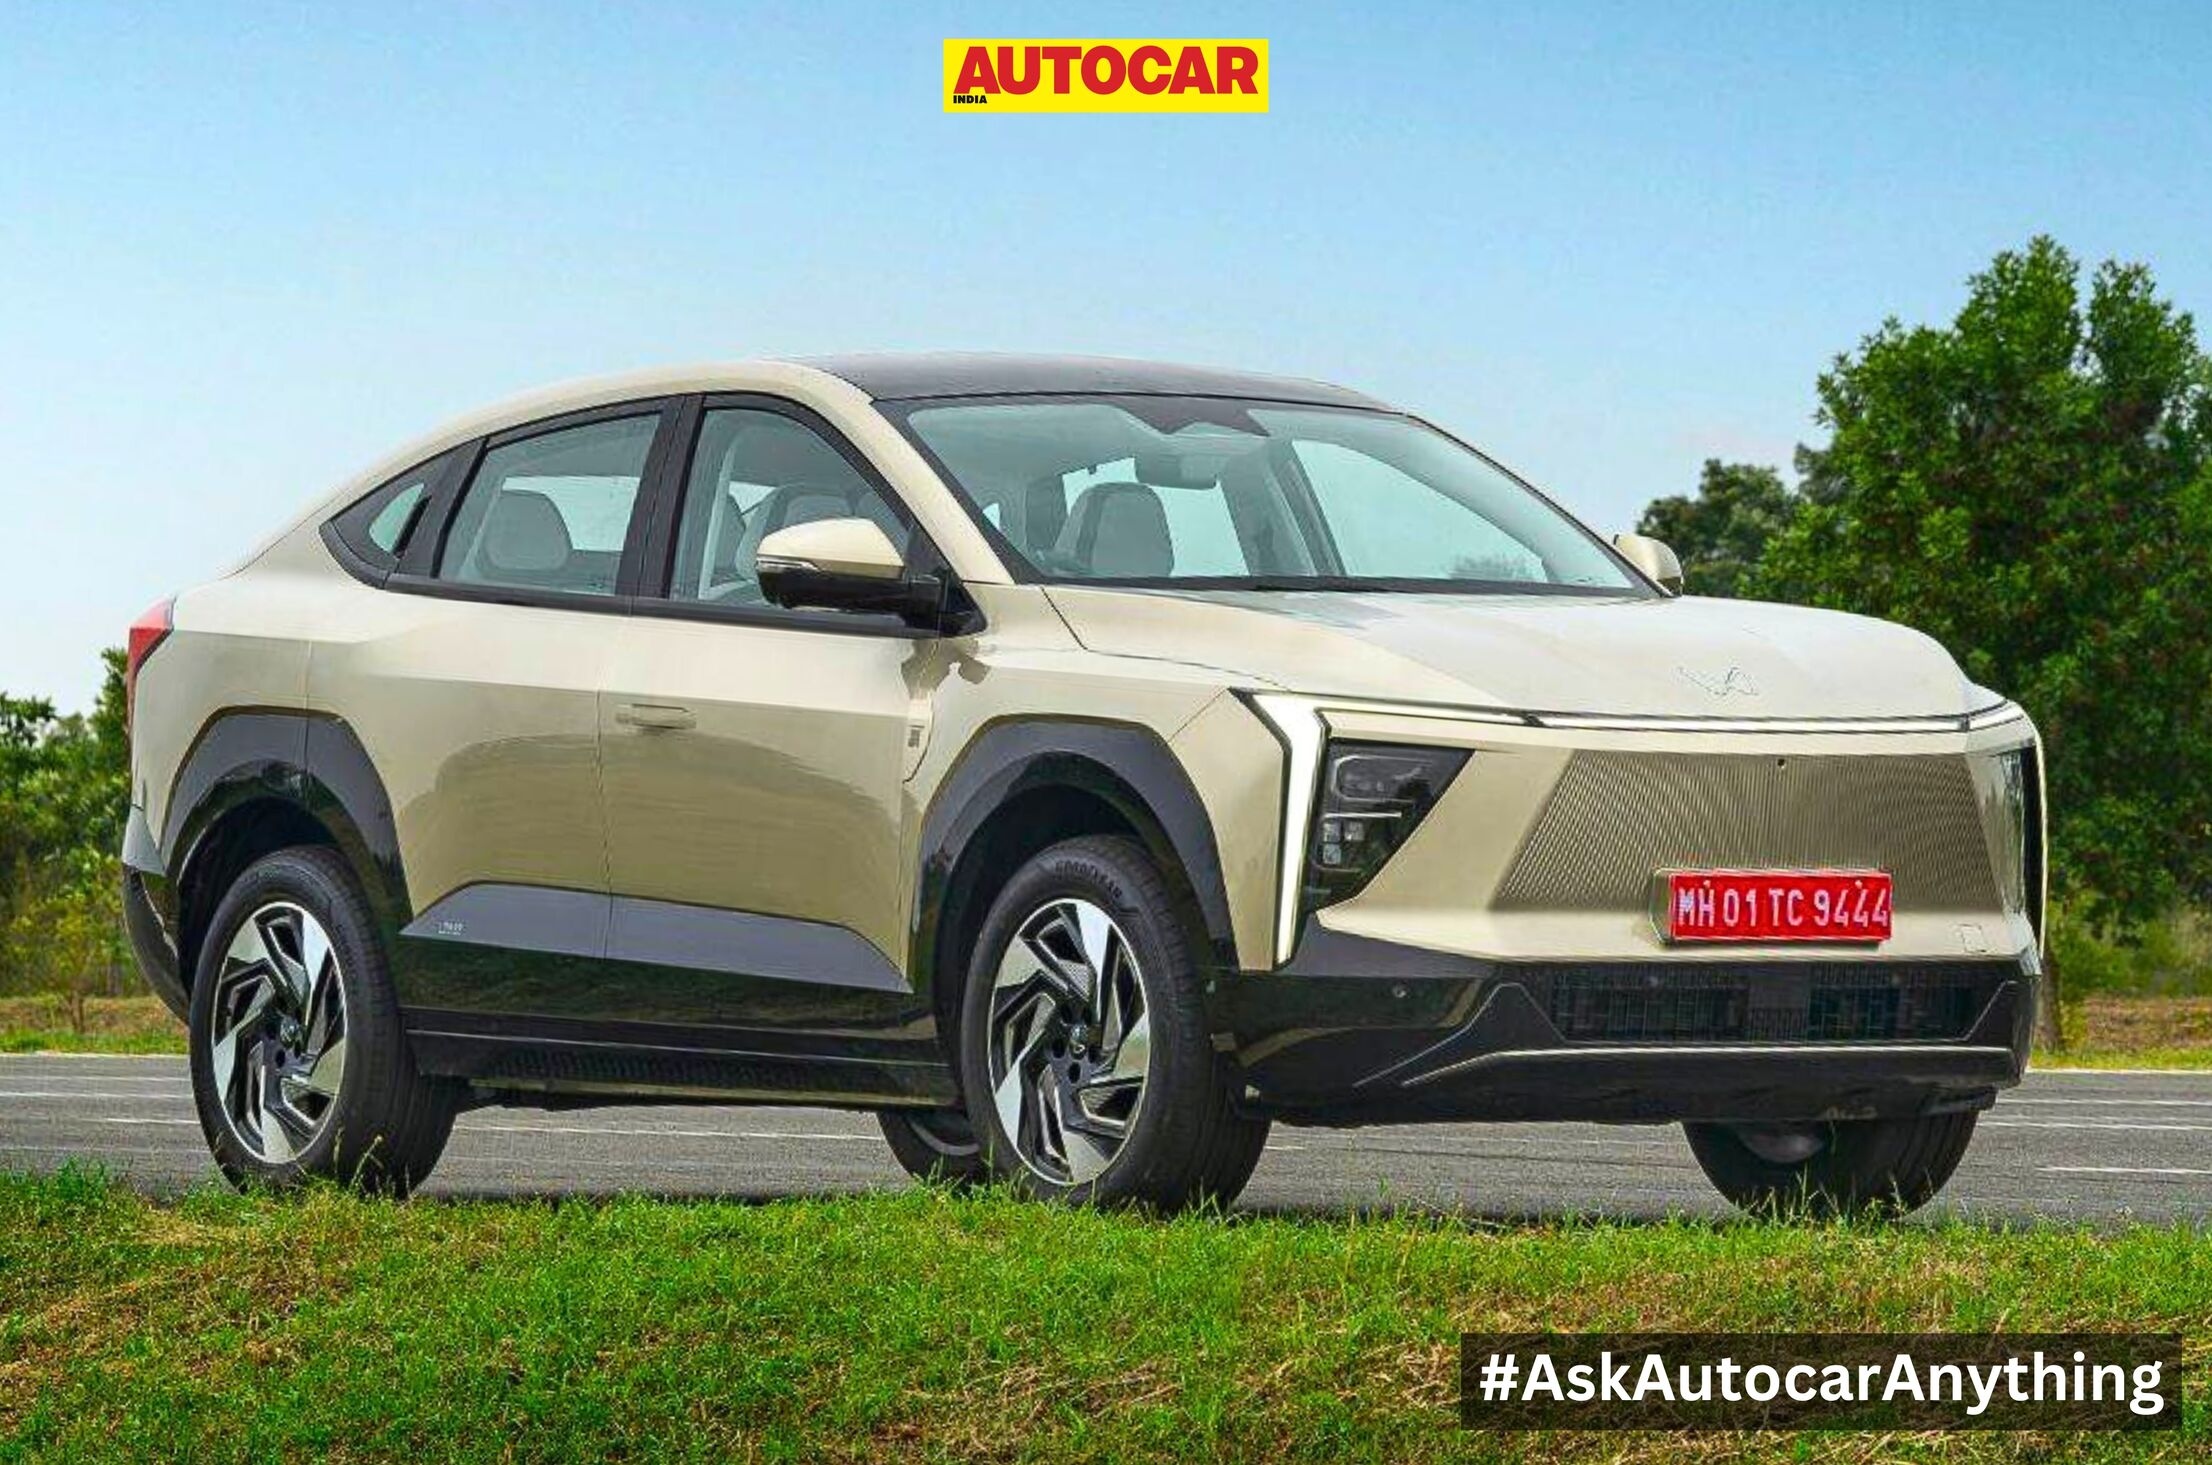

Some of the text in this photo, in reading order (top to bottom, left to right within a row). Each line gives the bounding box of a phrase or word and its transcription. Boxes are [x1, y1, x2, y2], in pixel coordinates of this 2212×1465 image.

[1678, 887, 1889, 928] MH 01 TC 9444
